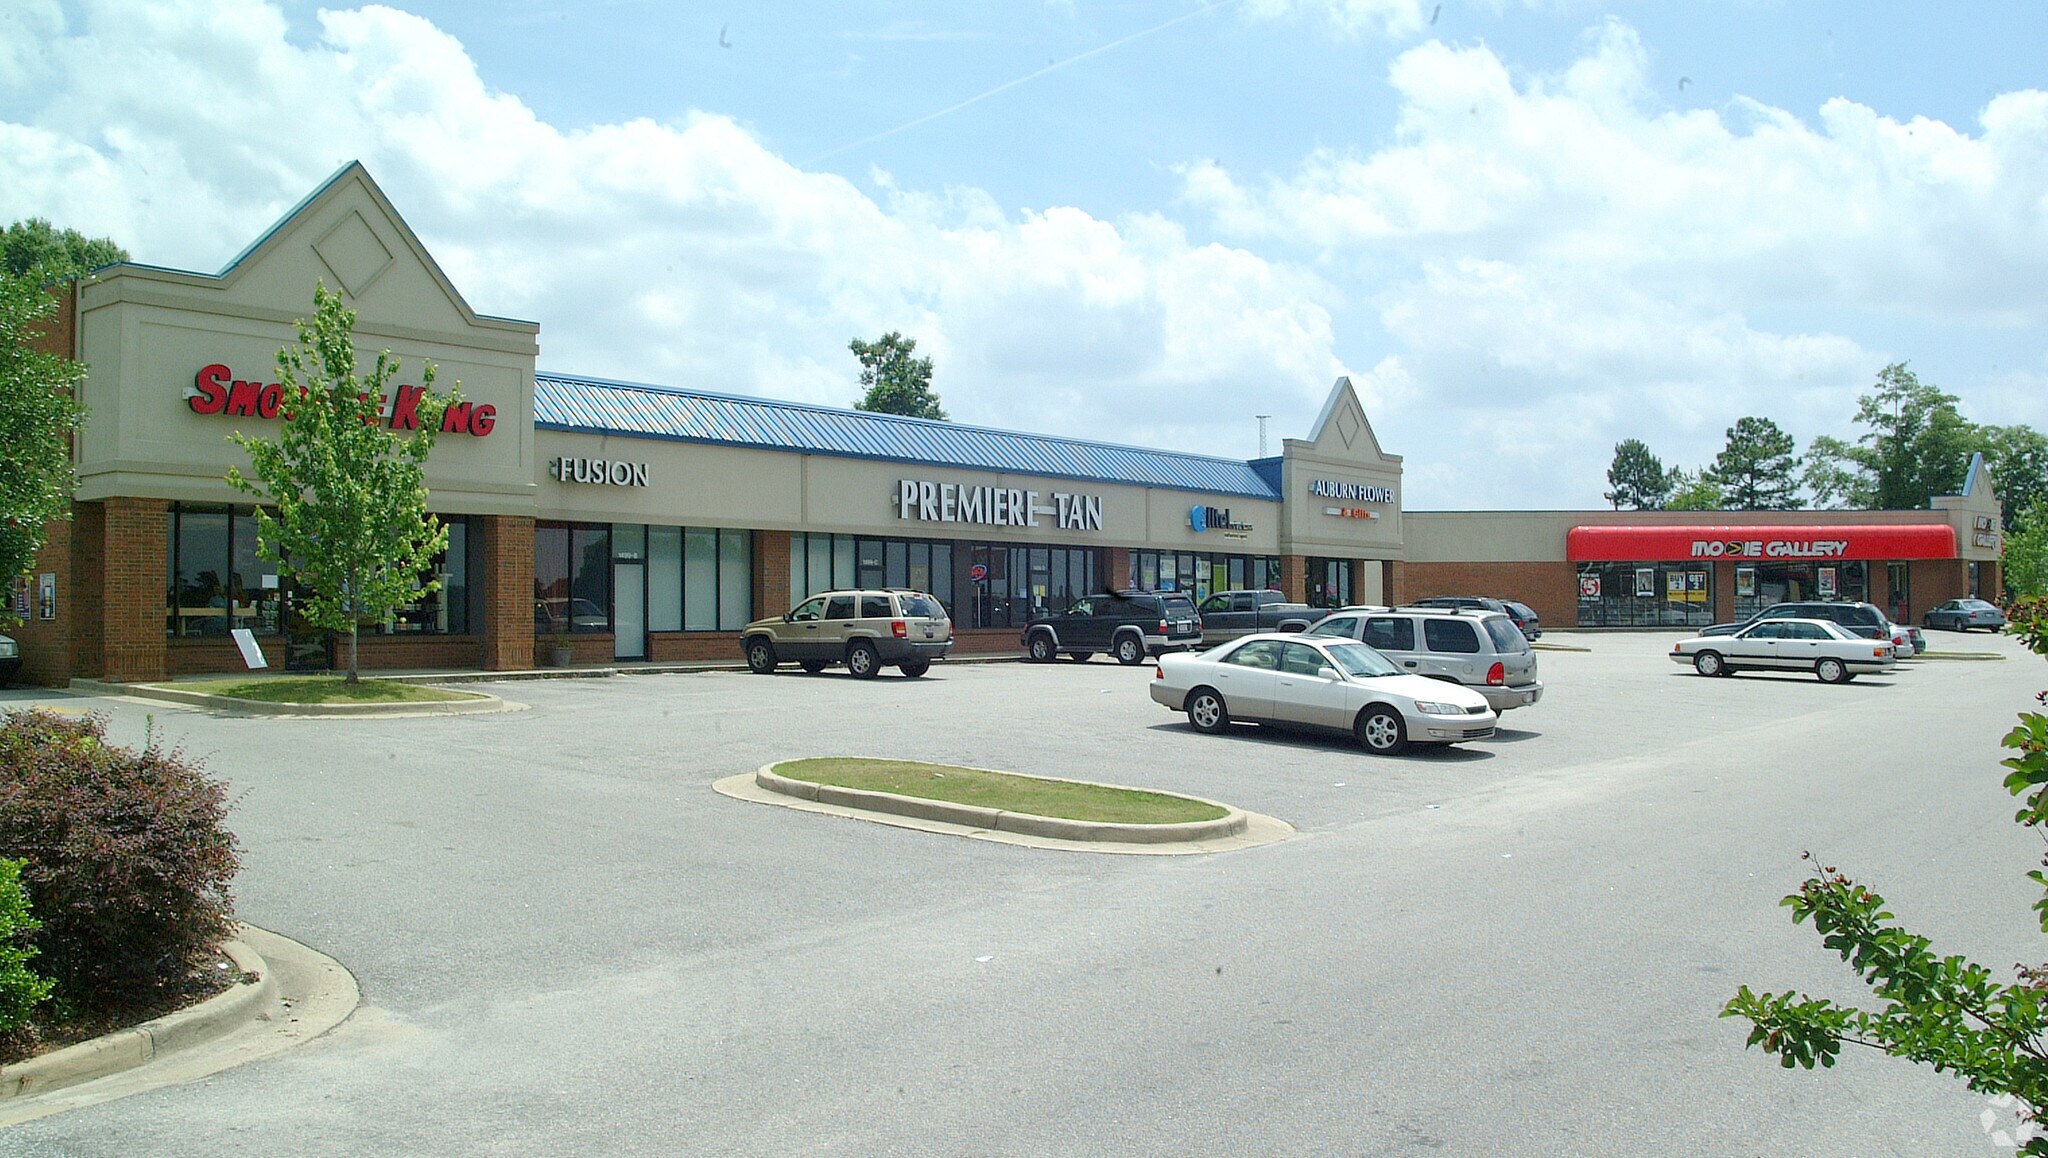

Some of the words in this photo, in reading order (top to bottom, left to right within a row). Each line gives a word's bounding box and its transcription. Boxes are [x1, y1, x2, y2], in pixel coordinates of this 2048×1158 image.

[389, 384, 497, 437] KNG
[558, 457, 650, 487] FUSION
[1315, 480, 1357, 500] AUBURN
[1358, 485, 1395, 503] FLOWER
[899, 479, 1040, 527] PREMIERE
[1051, 492, 1103, 530] TAN
[1765, 541, 1848, 557] GALLERY
[1670, 574, 1684, 582] BUY
[1688, 574, 1704, 582] GET
